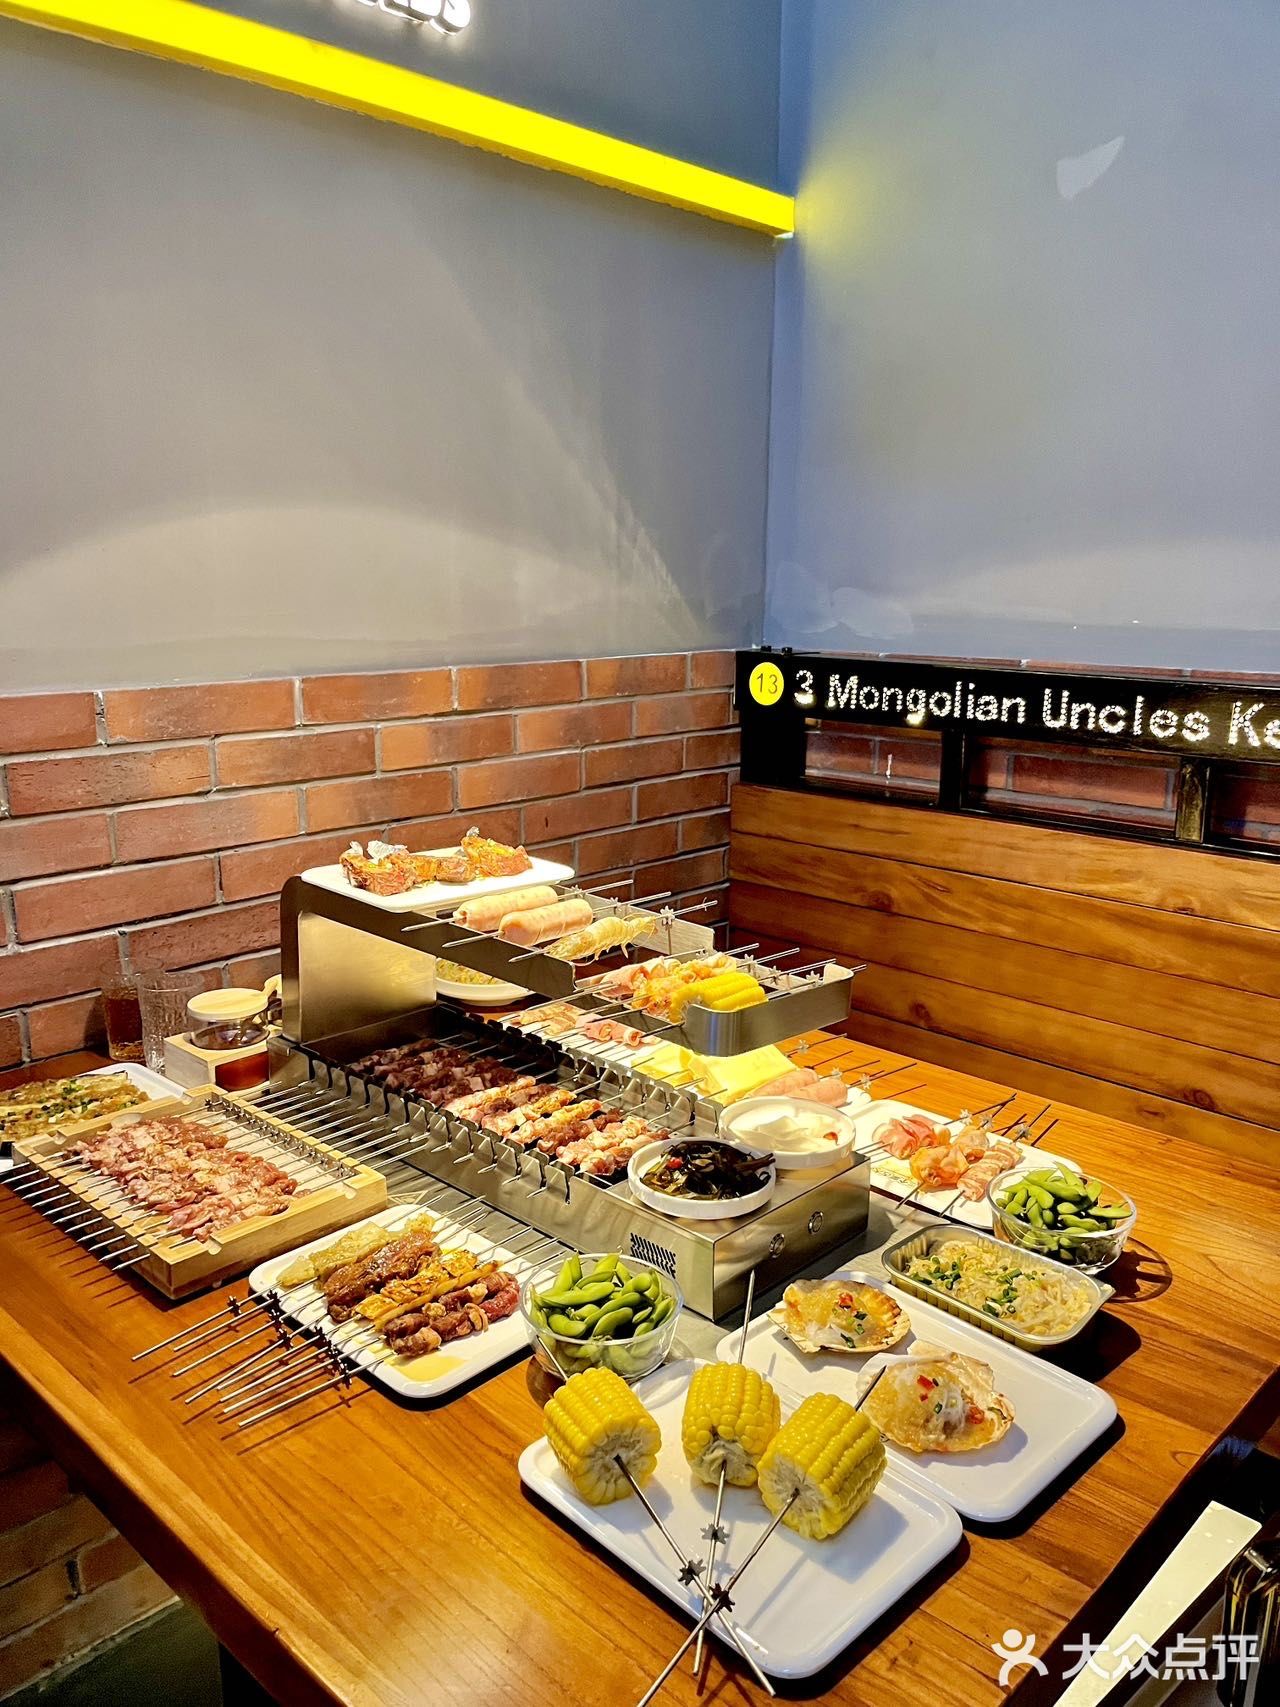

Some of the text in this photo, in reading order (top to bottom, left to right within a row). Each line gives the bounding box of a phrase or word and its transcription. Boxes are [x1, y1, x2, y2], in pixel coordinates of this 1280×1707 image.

[756, 673, 778, 695] 13
[794, 669, 815, 706] 3
[826, 674, 1026, 726] Mongolian
[1042, 688, 1210, 742] Uncles
